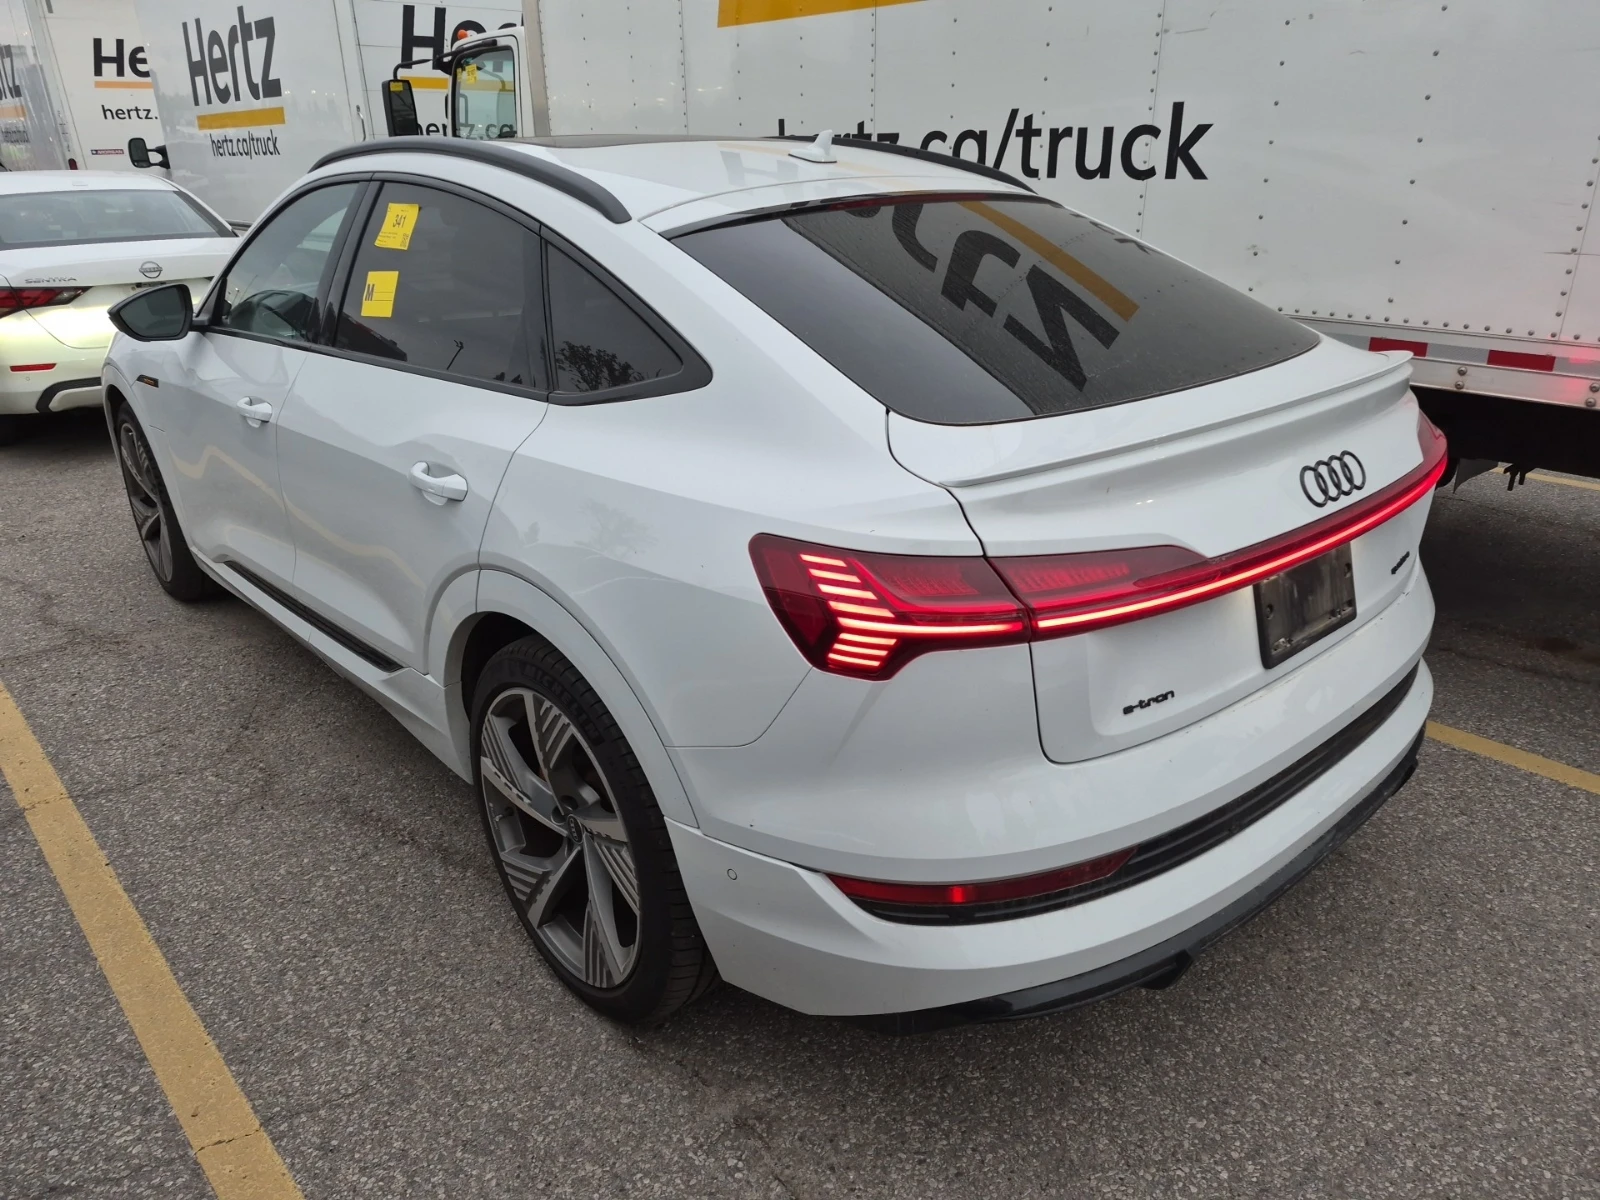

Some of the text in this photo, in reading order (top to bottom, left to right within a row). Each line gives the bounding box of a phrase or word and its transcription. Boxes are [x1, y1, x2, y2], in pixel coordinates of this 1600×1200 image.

[182, 5, 282, 107] Hertz
[101, 105, 158, 120] hertz.
[210, 129, 280, 160] hertz.ca/truck
[25, 276, 78, 284] SENTRA
[1123, 690, 1175, 715] e-tron
